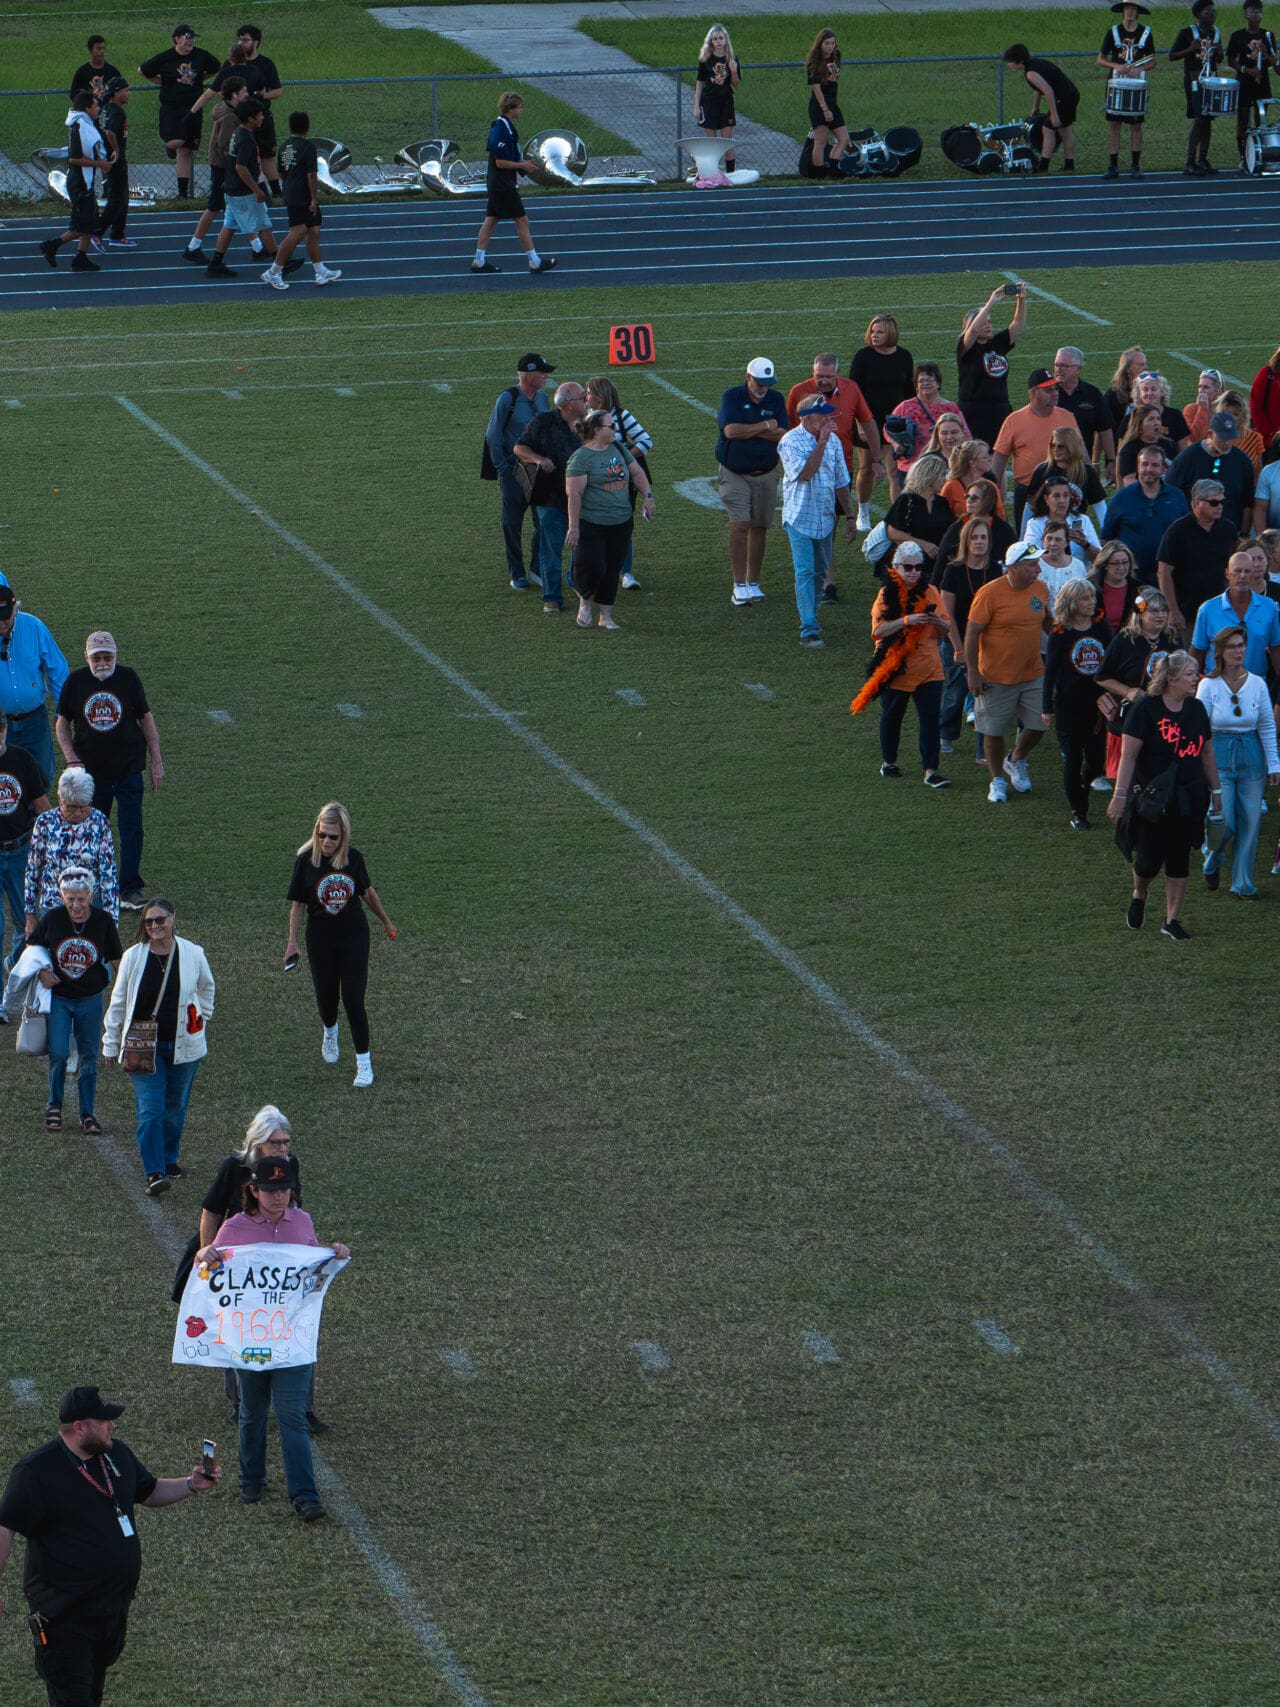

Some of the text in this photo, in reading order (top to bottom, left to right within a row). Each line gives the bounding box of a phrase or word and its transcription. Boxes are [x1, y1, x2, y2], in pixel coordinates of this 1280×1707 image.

[615, 325, 651, 362] 30
[328, 890, 347, 898] 100
[68, 953, 86, 962] 100
[186, 1001, 204, 1036] L
[208, 1265, 308, 1294] CLASSES
[219, 1291, 286, 1308] OF THE
